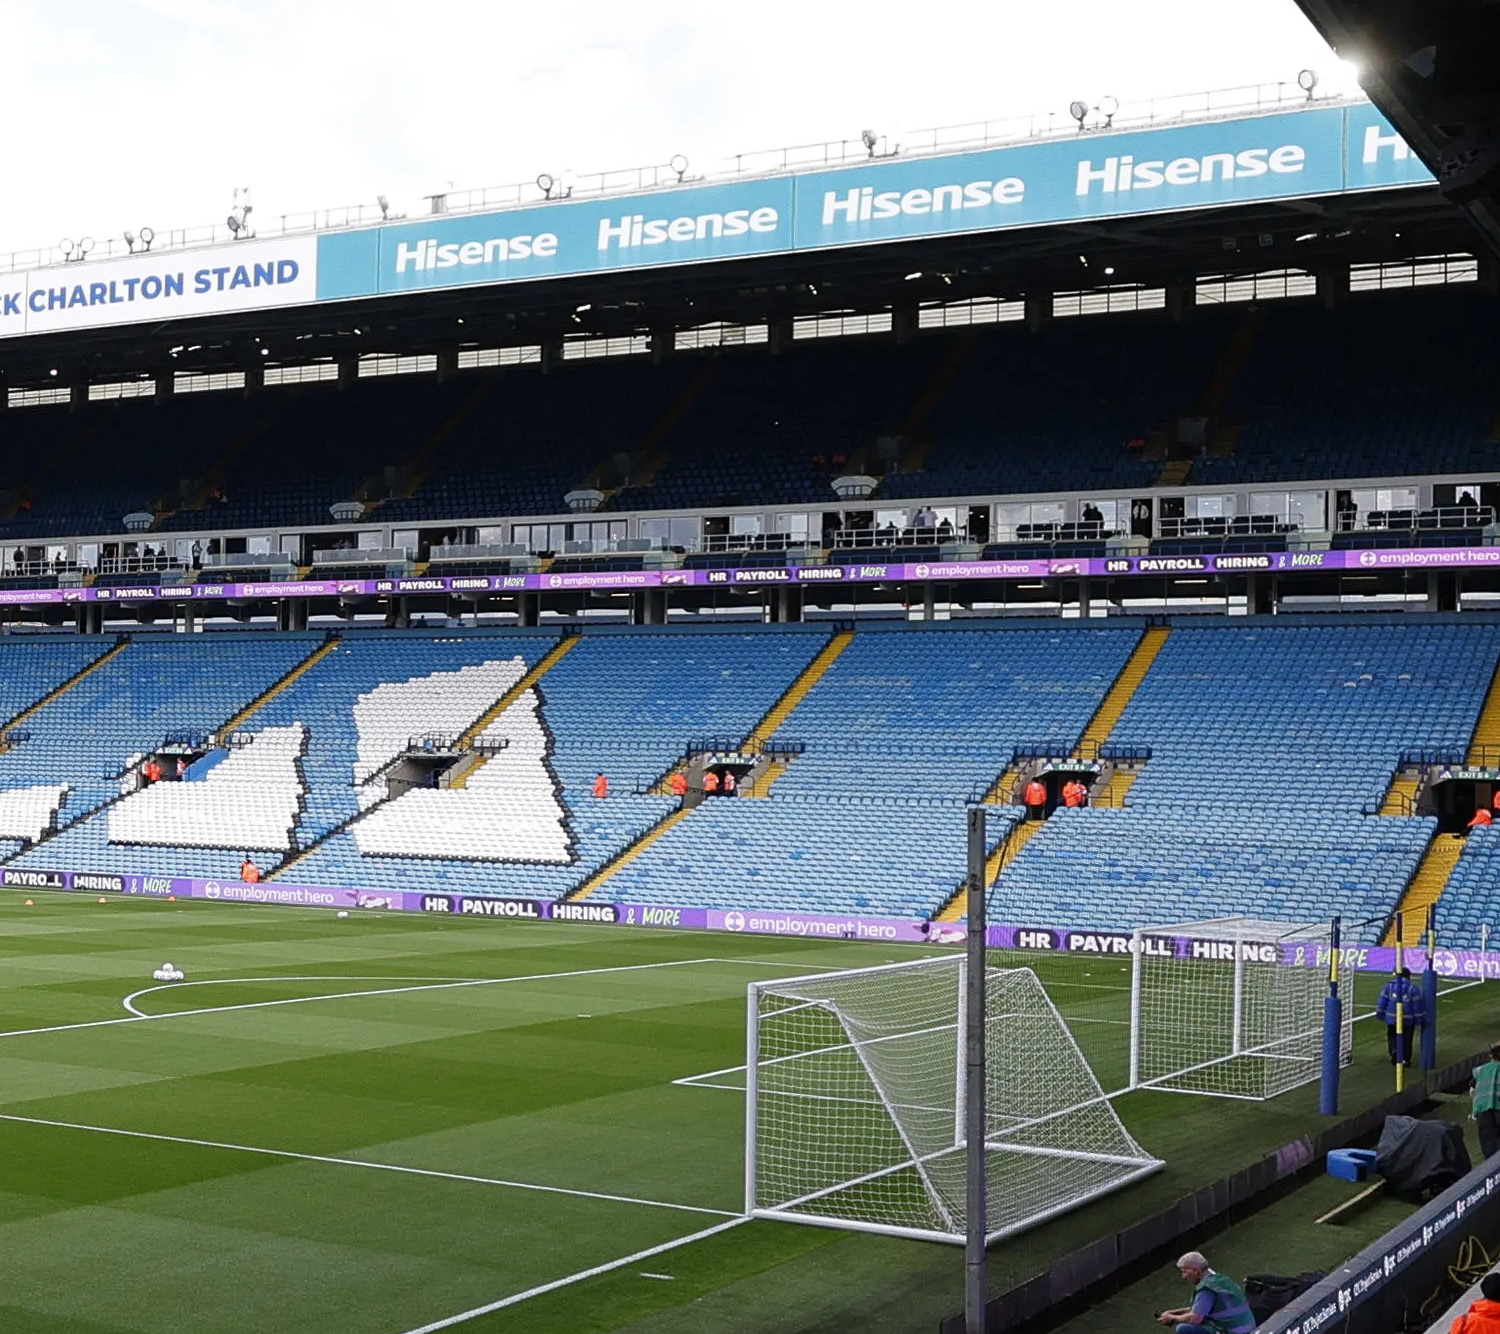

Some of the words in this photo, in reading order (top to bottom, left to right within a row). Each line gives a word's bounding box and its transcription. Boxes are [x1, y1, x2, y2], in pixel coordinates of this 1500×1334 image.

[1075, 143, 1305, 195] Hisense
[822, 174, 1025, 224] Hisense
[598, 203, 778, 250] Hisense
[396, 231, 558, 273] Hisense
[28, 272, 188, 313] CHARLTON
[194, 259, 299, 294] STAND
[1108, 562, 1128, 571] HR
[1140, 559, 1204, 570] PAYROLL
[1217, 557, 1268, 568] HIRING
[1279, 557, 1285, 567] &
[1292, 554, 1324, 566] MORE
[1380, 553, 1467, 564] employment
[1469, 552, 1500, 561] hero
[564, 577, 622, 586] employment
[709, 572, 726, 581] HR
[736, 571, 789, 580] PAYROLL
[800, 569, 841, 578] HIRING
[850, 569, 855, 579] &
[861, 567, 887, 578] MORE
[932, 566, 1001, 577] employment
[1003, 564, 1029, 572] hero
[4, 872, 62, 886] PAYROL
[74, 876, 122, 890] HIRING
[131, 880, 138, 892] &
[143, 878, 172, 893] MORE
[223, 884, 300, 904] employment
[303, 888, 334, 904] hero
[425, 897, 449, 911] HR
[462, 898, 537, 917] PAYROLL
[552, 904, 614, 922] HIRING
[627, 908, 635, 924] &
[642, 907, 680, 925] MORE
[749, 915, 853, 938] employment
[857, 920, 896, 938] hero
[1020, 931, 1051, 949] HR
[1070, 935, 1170, 957] PAYROLL
[1193, 942, 1275, 962] HIRNG
